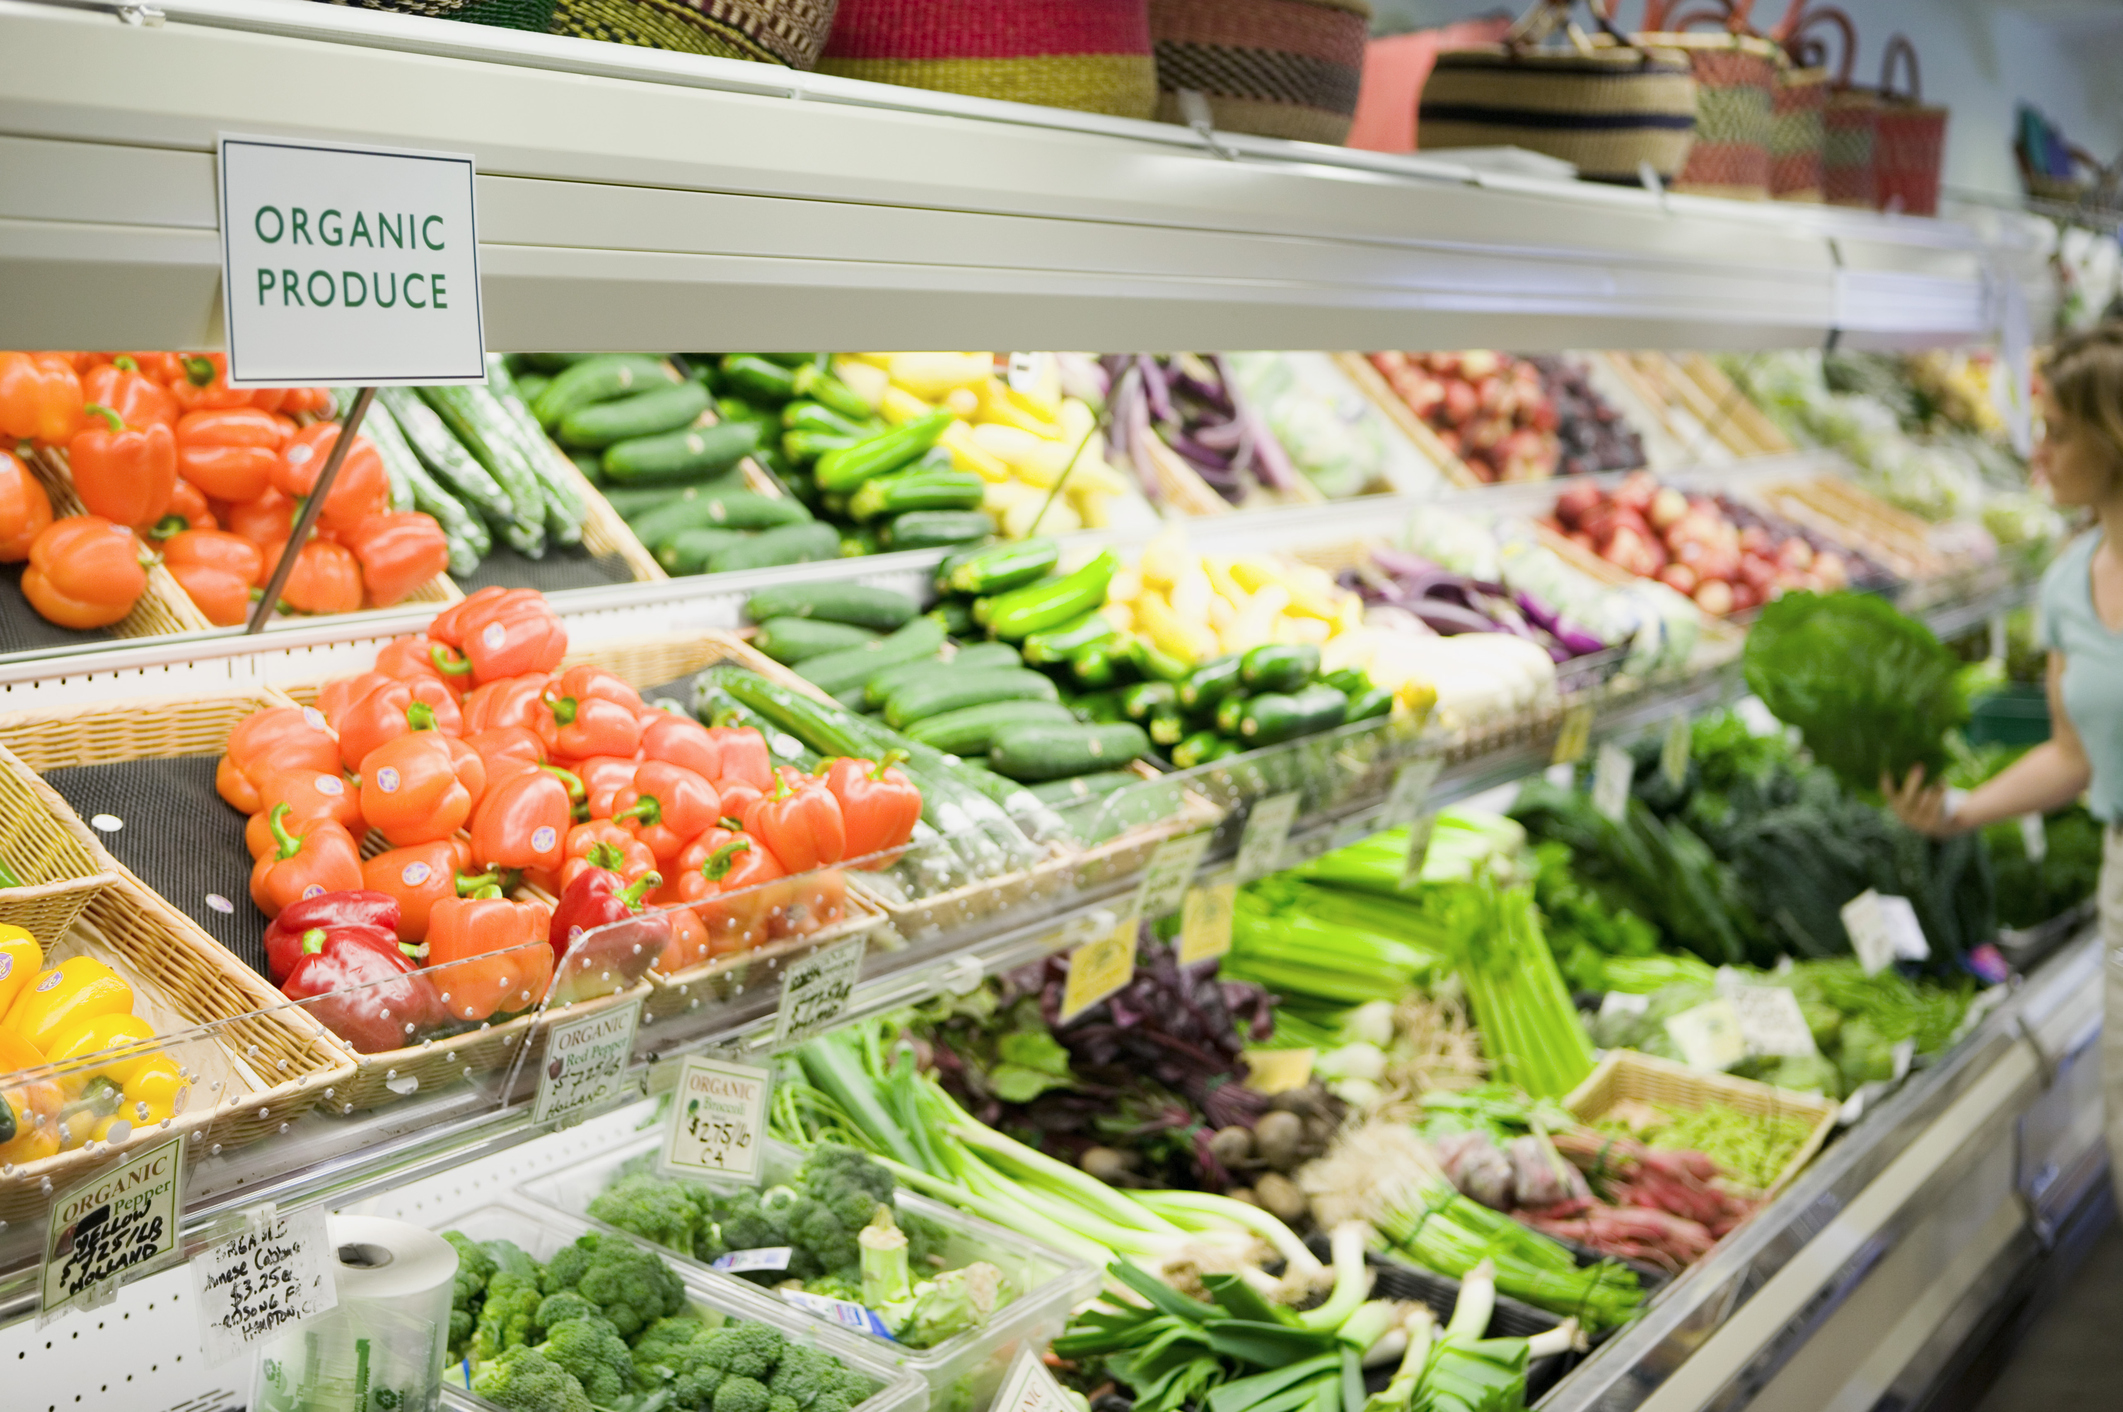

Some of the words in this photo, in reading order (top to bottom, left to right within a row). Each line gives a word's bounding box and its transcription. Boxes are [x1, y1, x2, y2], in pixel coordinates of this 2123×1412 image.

[254, 205, 446, 251] ORGANIC
[257, 268, 448, 309] PRODUCE
[559, 1013, 629, 1050] ORGANIC
[566, 1048, 589, 1067] Red
[592, 1037, 628, 1061] Pepper
[690, 1074, 756, 1101] ORGANIC
[703, 1095, 746, 1116] Broccoli
[62, 1156, 168, 1223] ORGANIC
[113, 1180, 171, 1217] Pepper
[75, 1200, 152, 1255] YELLOW
[69, 1243, 158, 1296] HOLLAND
